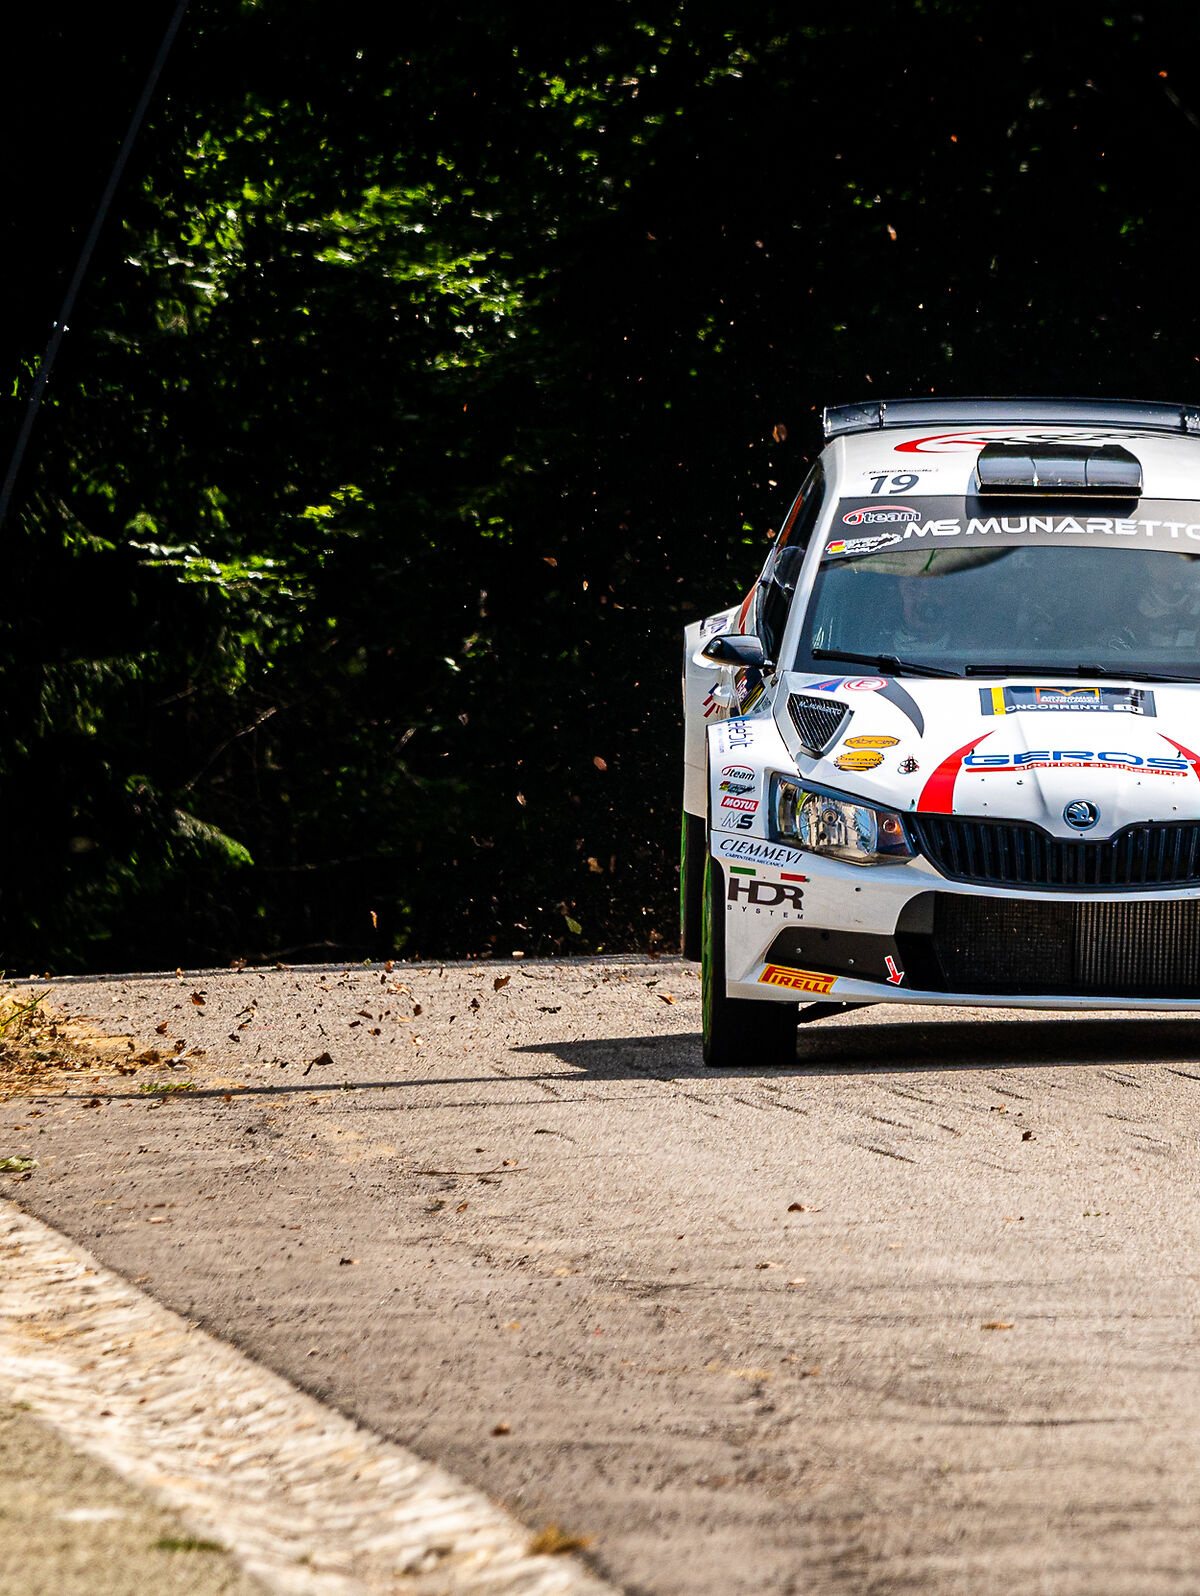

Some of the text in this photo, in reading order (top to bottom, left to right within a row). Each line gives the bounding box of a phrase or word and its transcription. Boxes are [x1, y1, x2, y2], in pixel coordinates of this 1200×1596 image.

[870, 474, 919, 494] 19
[903, 518, 961, 538] MS
[996, 703, 1109, 712] ONCORRENTE
[964, 750, 1189, 770] GEROS
[724, 798, 757, 811] MOTUL
[722, 811, 755, 829] MS
[720, 838, 803, 864] CIEMMEVI
[728, 877, 804, 910] HDR
[727, 904, 804, 919] SYSTEM
[761, 965, 836, 993] PIRELLI
